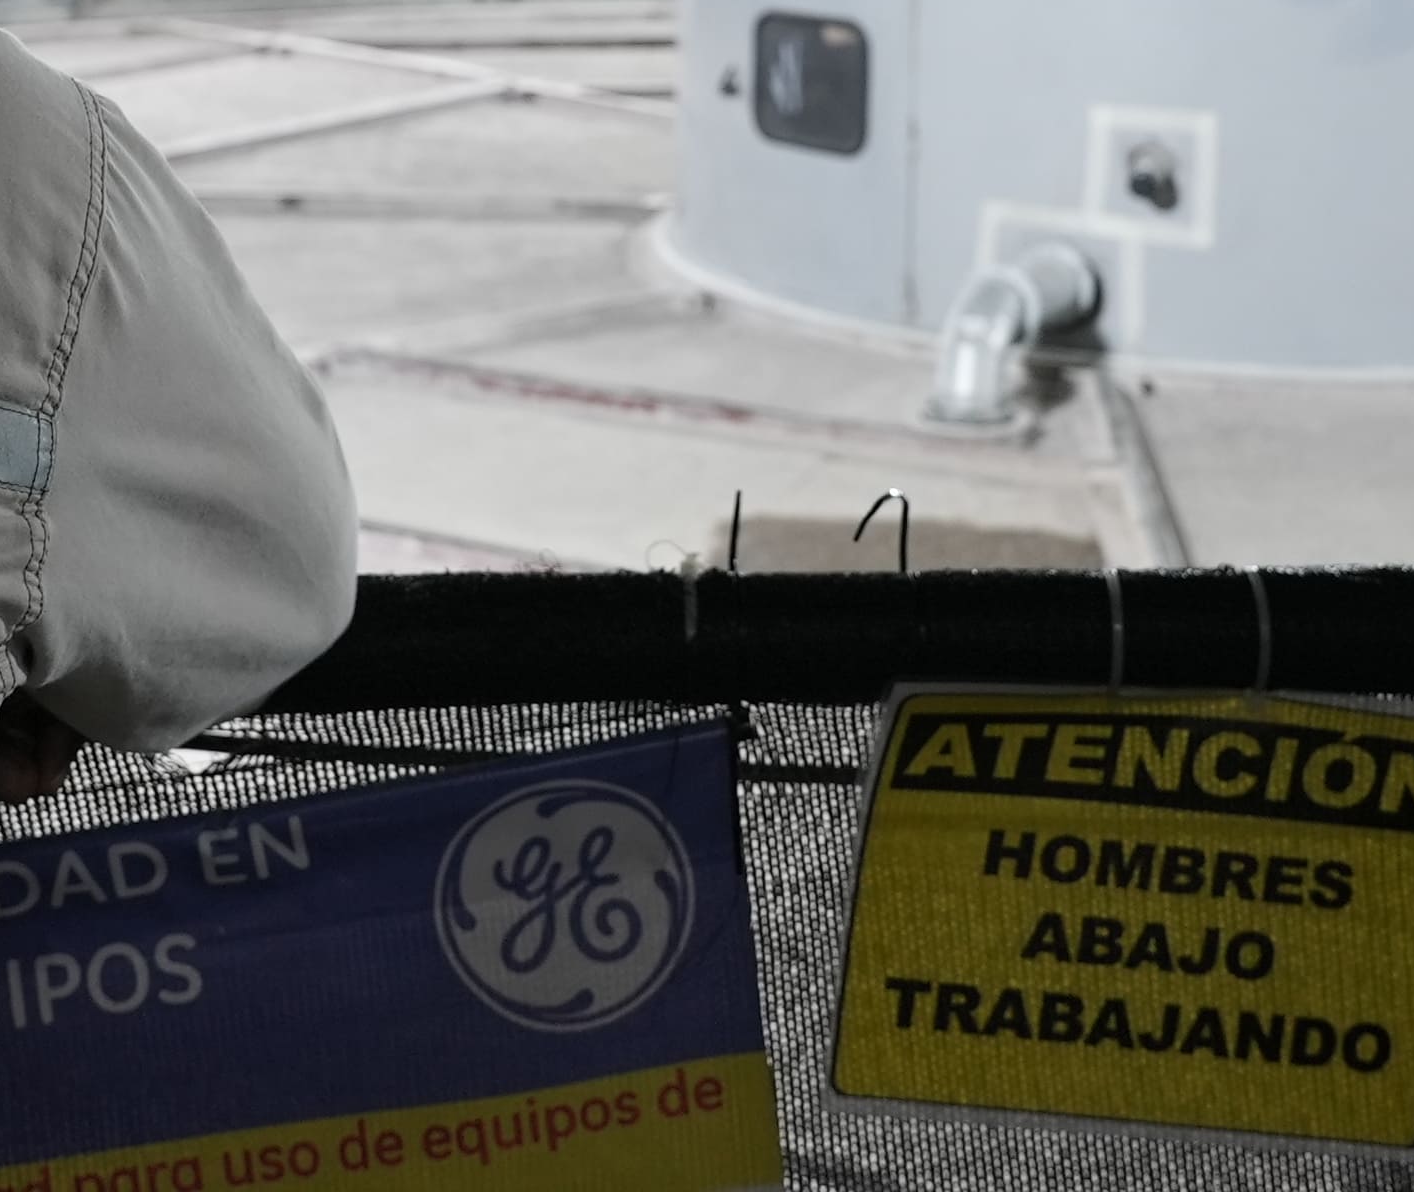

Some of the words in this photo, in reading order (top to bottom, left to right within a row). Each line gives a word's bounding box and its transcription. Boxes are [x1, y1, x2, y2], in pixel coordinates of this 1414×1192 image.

[984, 830, 1354, 909] HOMBRES
[1022, 914, 1276, 979] ABAJO
[887, 977, 1392, 1073] TRABAJANDO
[224, 1137, 321, 1185] uso
[339, 1120, 405, 1172] de
[425, 1092, 640, 1162] equipos
[657, 1069, 725, 1118] de
